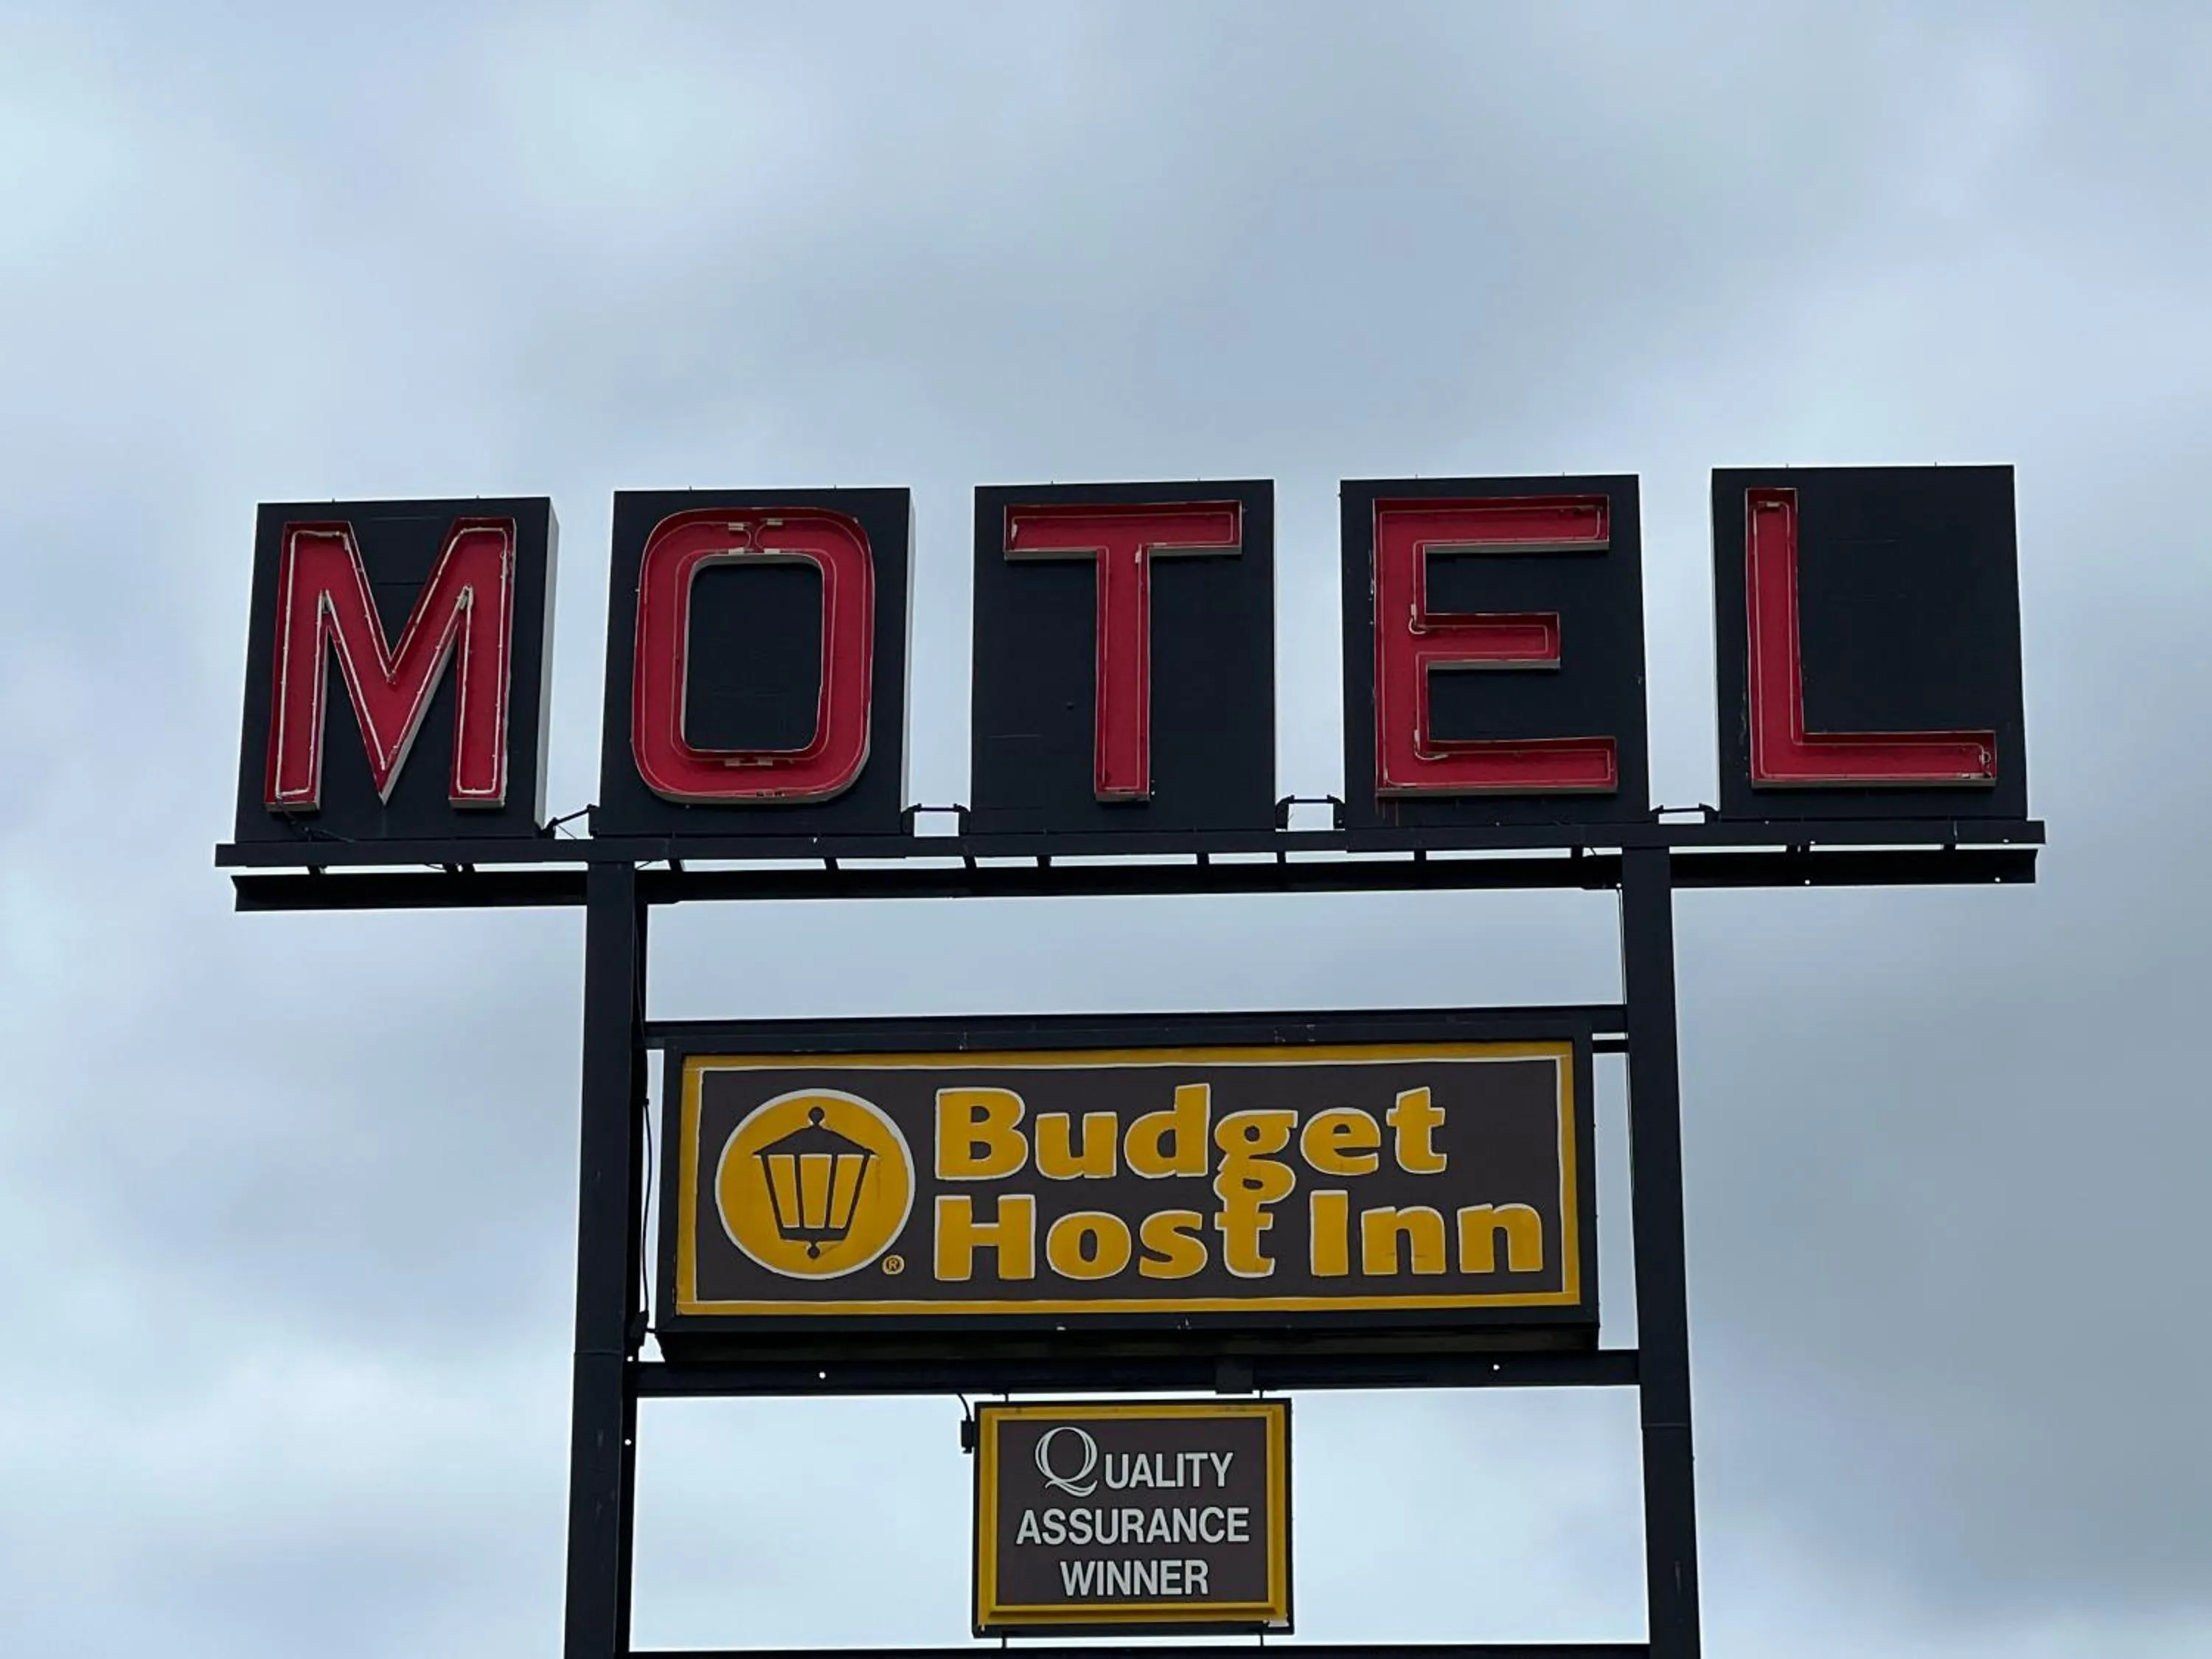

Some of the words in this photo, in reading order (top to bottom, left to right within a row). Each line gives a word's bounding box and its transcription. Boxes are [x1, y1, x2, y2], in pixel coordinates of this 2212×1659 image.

[265, 487, 1996, 813] MOTEL
[935, 1083, 1447, 1203] Budget
[934, 1194, 1275, 1281] Host
[1310, 1189, 1543, 1277] Inn
[1034, 1427, 1234, 1498] QUALITY
[1015, 1506, 1251, 1545] ASSURANCE
[1060, 1559, 1209, 1596] WINNER
